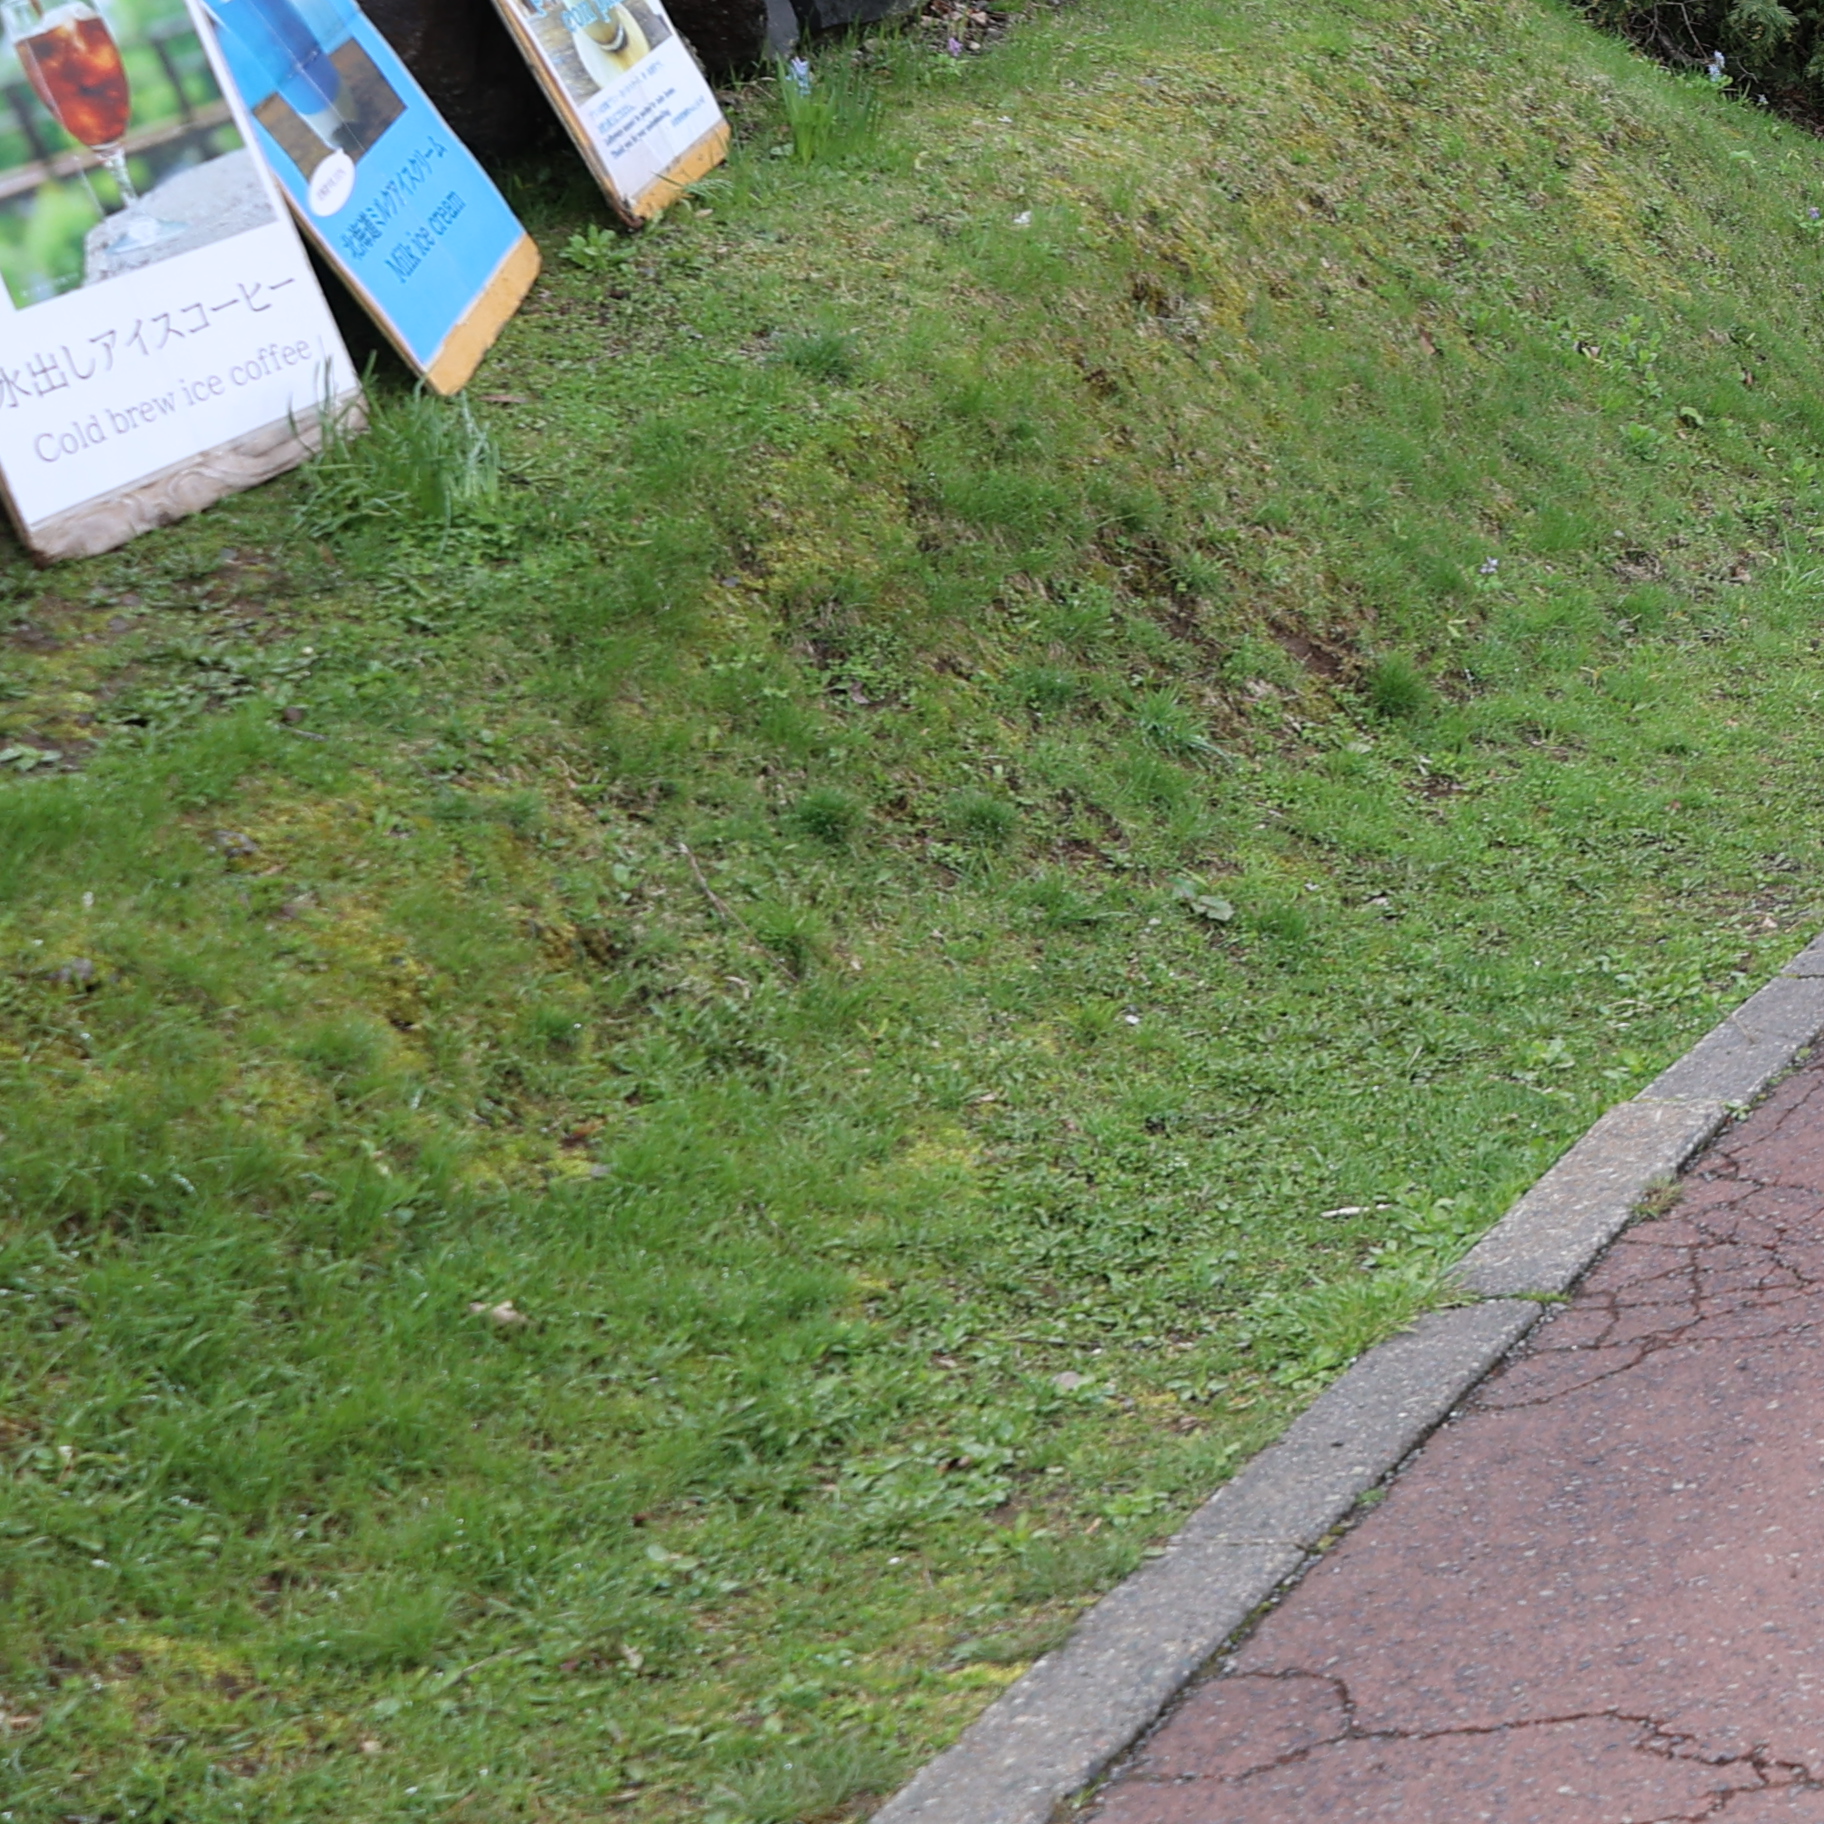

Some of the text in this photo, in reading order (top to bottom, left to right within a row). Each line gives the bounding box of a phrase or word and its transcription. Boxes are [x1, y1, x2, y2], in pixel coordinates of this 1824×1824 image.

[383, 190, 468, 284] Milk ice cream
[34, 338, 313, 463] Cold brew ice coffee
